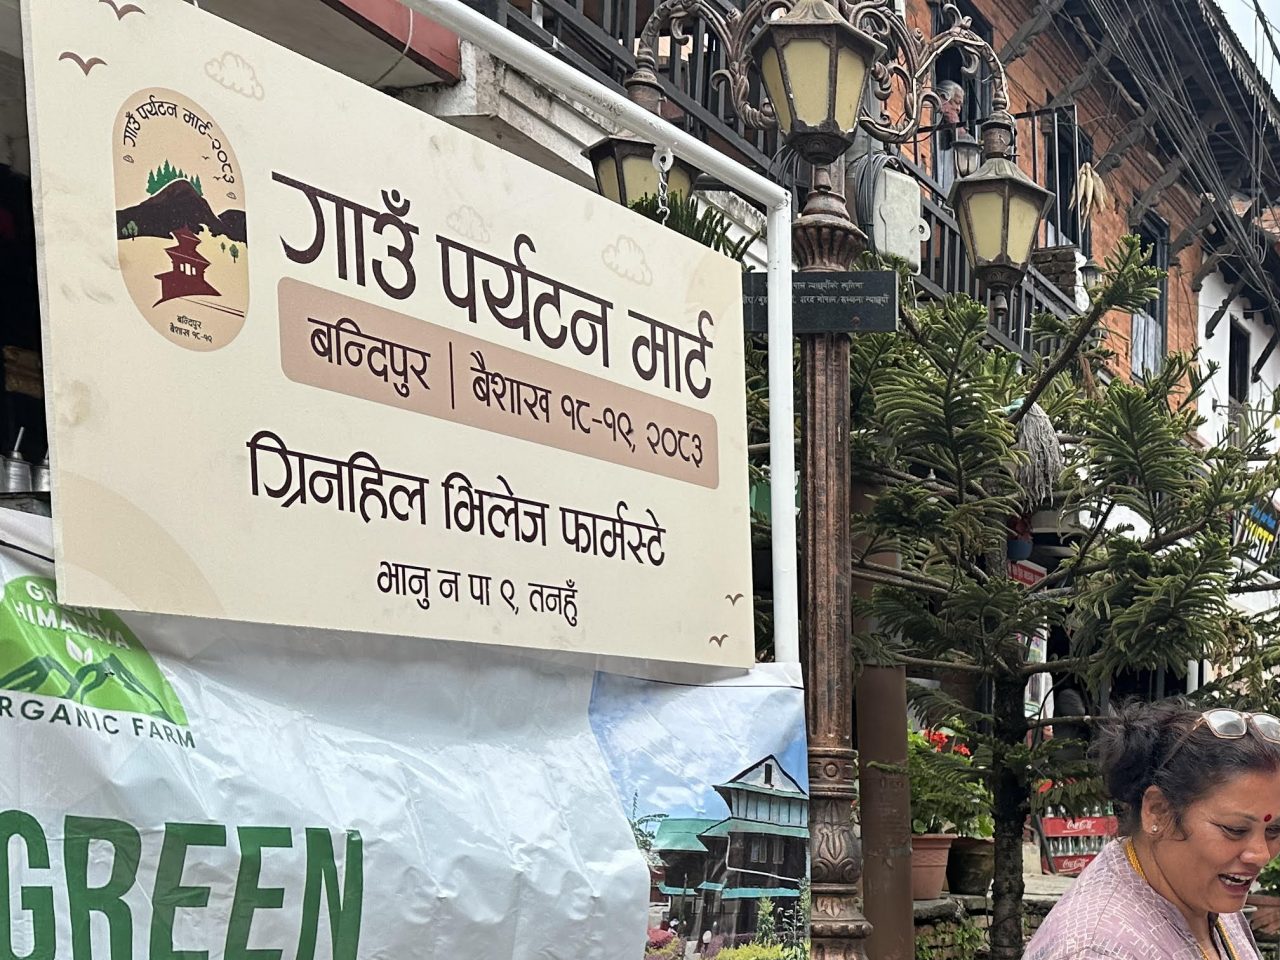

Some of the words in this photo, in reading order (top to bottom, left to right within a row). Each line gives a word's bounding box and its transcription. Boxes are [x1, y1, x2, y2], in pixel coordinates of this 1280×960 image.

[271, 171, 420, 300] गाउँ
[435, 233, 614, 369] पर्यटन
[627, 309, 715, 399] मार्ट
[306, 317, 431, 398] बन्दिपुर
[470, 350, 552, 424] बैशाख
[646, 421, 704, 468] २०८३
[246, 430, 429, 525] ग्रिनहिल
[442, 473, 549, 547] भिलेज
[559, 501, 667, 568] फार्मस्टे
[11, 599, 131, 650] HIMALAYA
[377, 560, 433, 611] भानु
[438, 568, 463, 601] न
[469, 573, 493, 608] पा
[528, 580, 580, 627] तनहुँ
[132, 717, 196, 749] FARM
